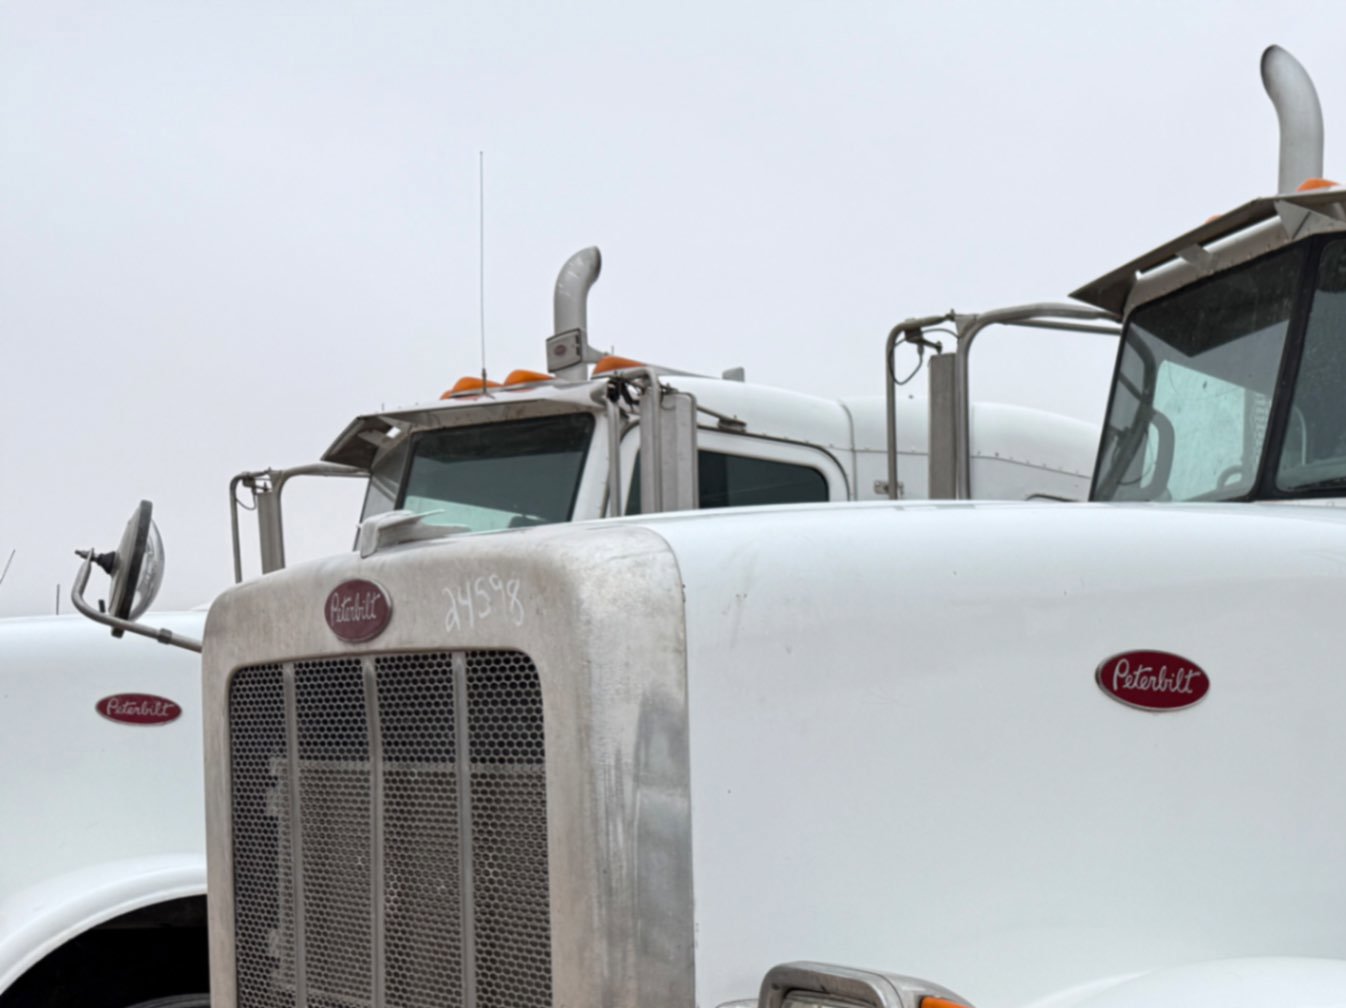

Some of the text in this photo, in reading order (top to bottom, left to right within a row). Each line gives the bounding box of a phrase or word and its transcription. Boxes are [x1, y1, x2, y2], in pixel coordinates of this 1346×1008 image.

[330, 591, 382, 627] Peterbilt
[442, 574, 525, 632] 24598
[1112, 658, 1201, 694] Peterbilt
[106, 697, 176, 717] Peterbilt
